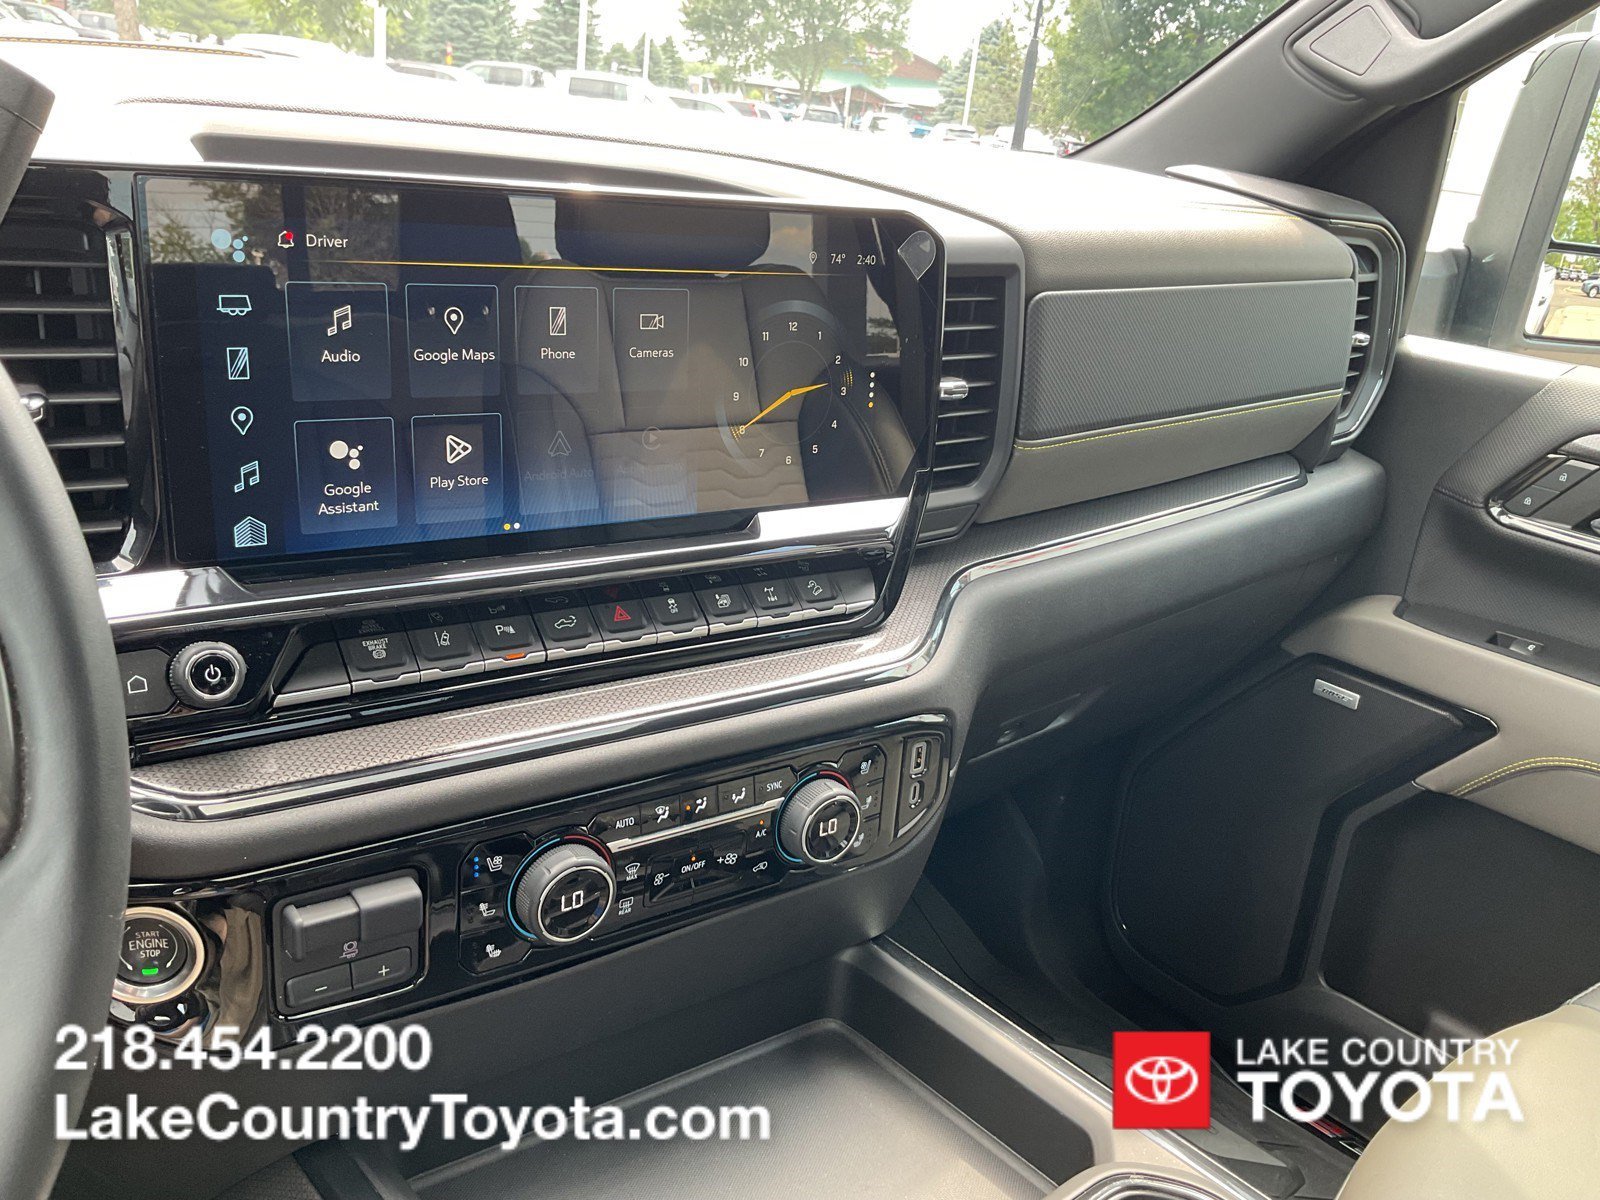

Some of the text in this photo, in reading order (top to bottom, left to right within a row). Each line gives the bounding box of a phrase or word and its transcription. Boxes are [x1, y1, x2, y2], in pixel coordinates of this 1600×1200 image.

[306, 233, 348, 248] Driver
[857, 255, 876, 265] 2:40
[788, 322, 798, 331] 12
[762, 332, 769, 341] 11
[321, 349, 361, 363] Audio
[414, 348, 495, 364] Google Maps
[540, 348, 576, 359] Phone
[629, 347, 674, 358] Cameras
[739, 357, 748, 367] 10
[835, 356, 841, 365] 2
[840, 386, 846, 396] 3
[733, 392, 739, 401] 9
[832, 420, 837, 429] 4
[758, 449, 764, 457] 7
[812, 445, 818, 454] 5
[786, 456, 791, 465] 6
[430, 475, 489, 491] Play Store
[324, 482, 372, 498] Google
[318, 500, 379, 515] Assistant
[362, 638, 388, 647] EXHAUST
[766, 781, 782, 791] SYNC
[616, 817, 634, 829] AUTO
[756, 829, 767, 838] A/C
[681, 860, 706, 874] ON/OFF
[618, 907, 632, 915] REAR
[135, 930, 160, 939] START
[128, 938, 169, 951] ENGINE
[140, 949, 161, 958] STOP
